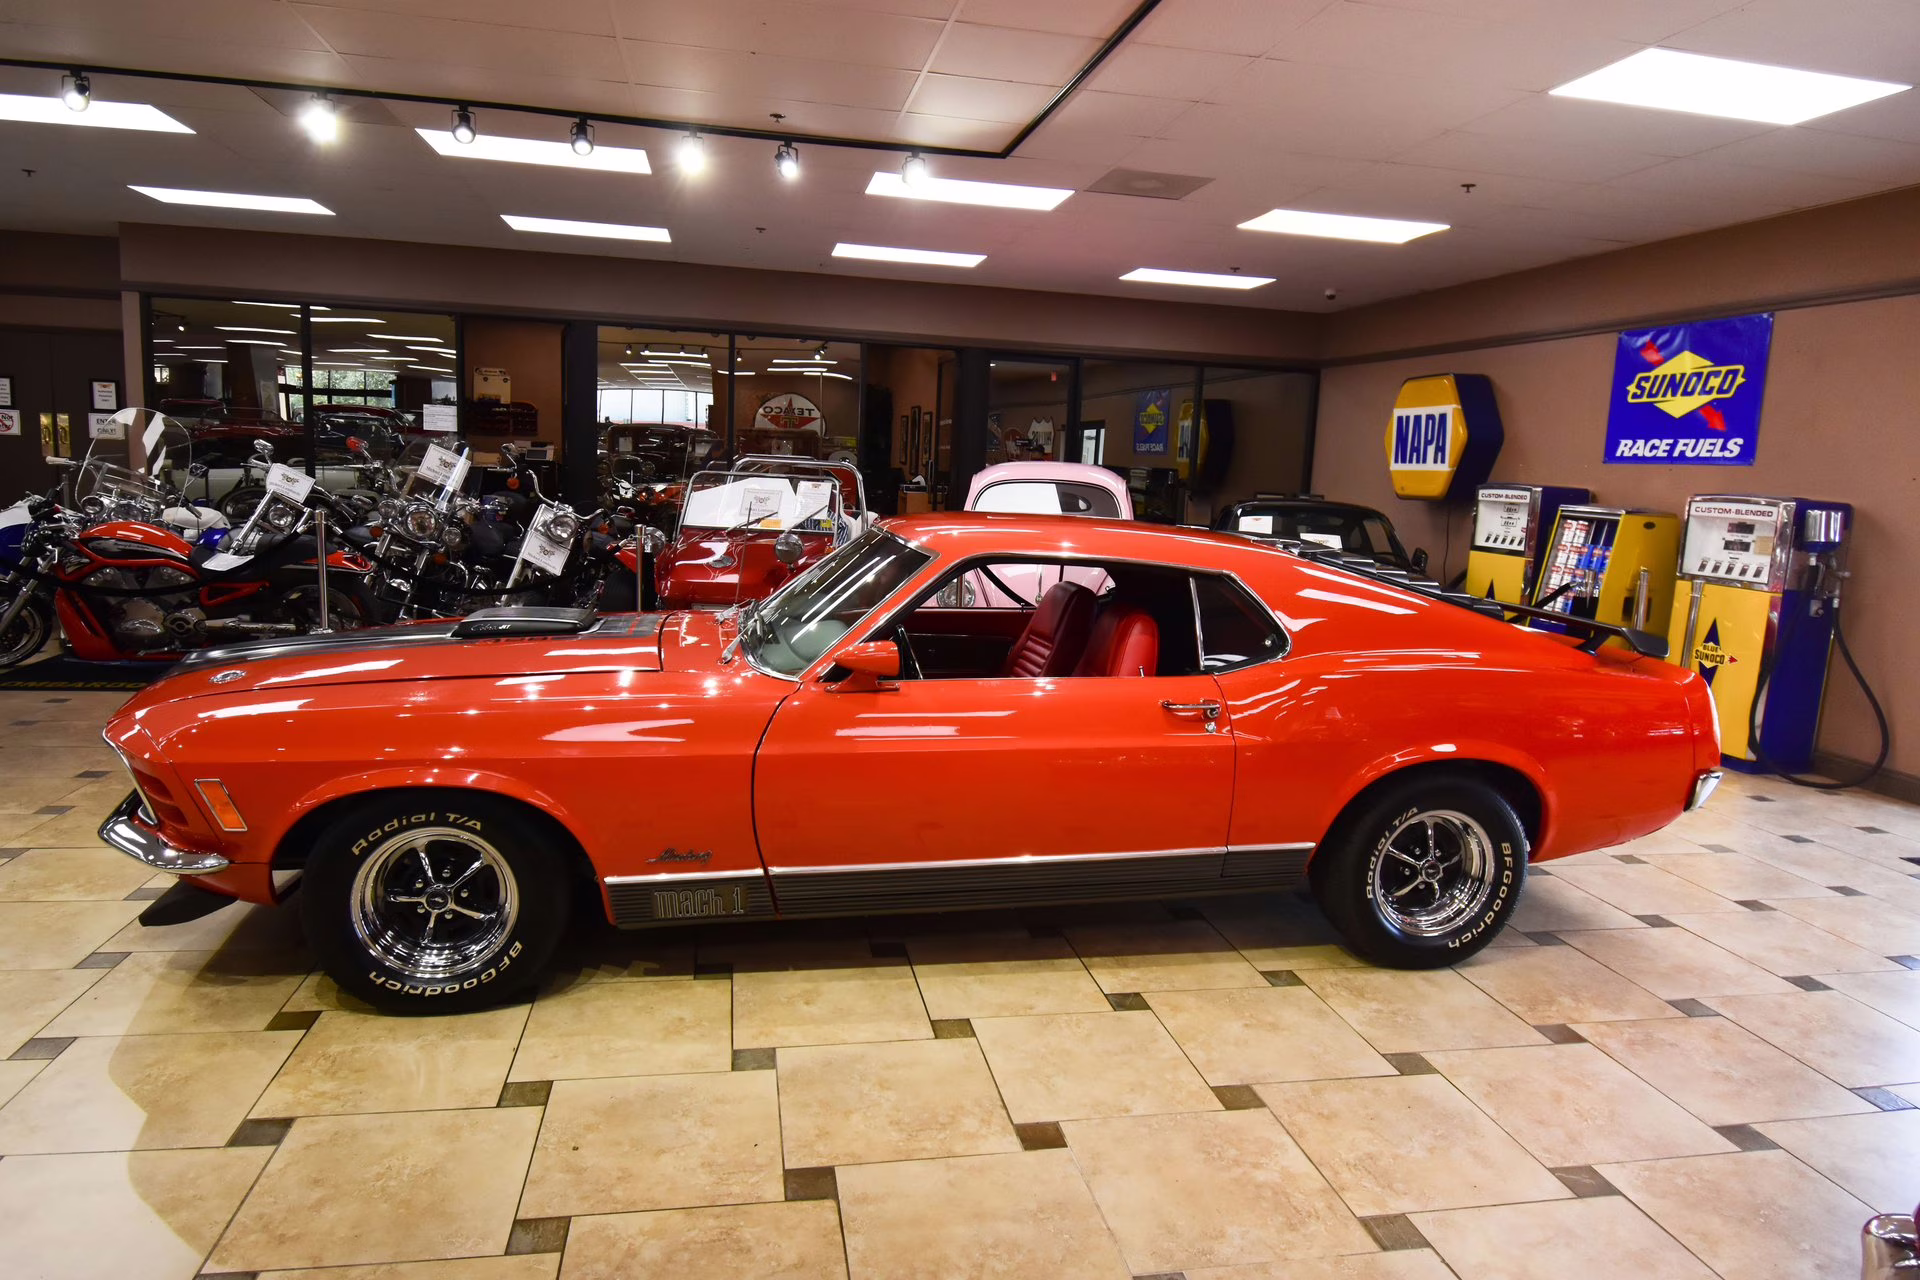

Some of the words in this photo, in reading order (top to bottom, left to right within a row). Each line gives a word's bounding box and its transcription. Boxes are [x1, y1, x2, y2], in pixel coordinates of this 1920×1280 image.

[1630, 368, 1741, 400] SUNOCO
[1394, 412, 1447, 464] NAPA
[1615, 438, 1674, 458] RACE
[1672, 437, 1744, 458] FUELS
[1694, 506, 1774, 518] CUSTOM-BLENDED
[1694, 649, 1726, 665] SUNOCO
[1703, 644, 1719, 653] BLUE
[351, 812, 435, 856] Radial
[445, 813, 483, 831] T/A
[1365, 830, 1390, 899] Radial
[1392, 806, 1418, 827] T/A
[654, 888, 726, 918] mach
[733, 886, 744, 915] 1
[1448, 842, 1513, 949] BFGoodrich
[369, 940, 523, 997] BFGoodrich
